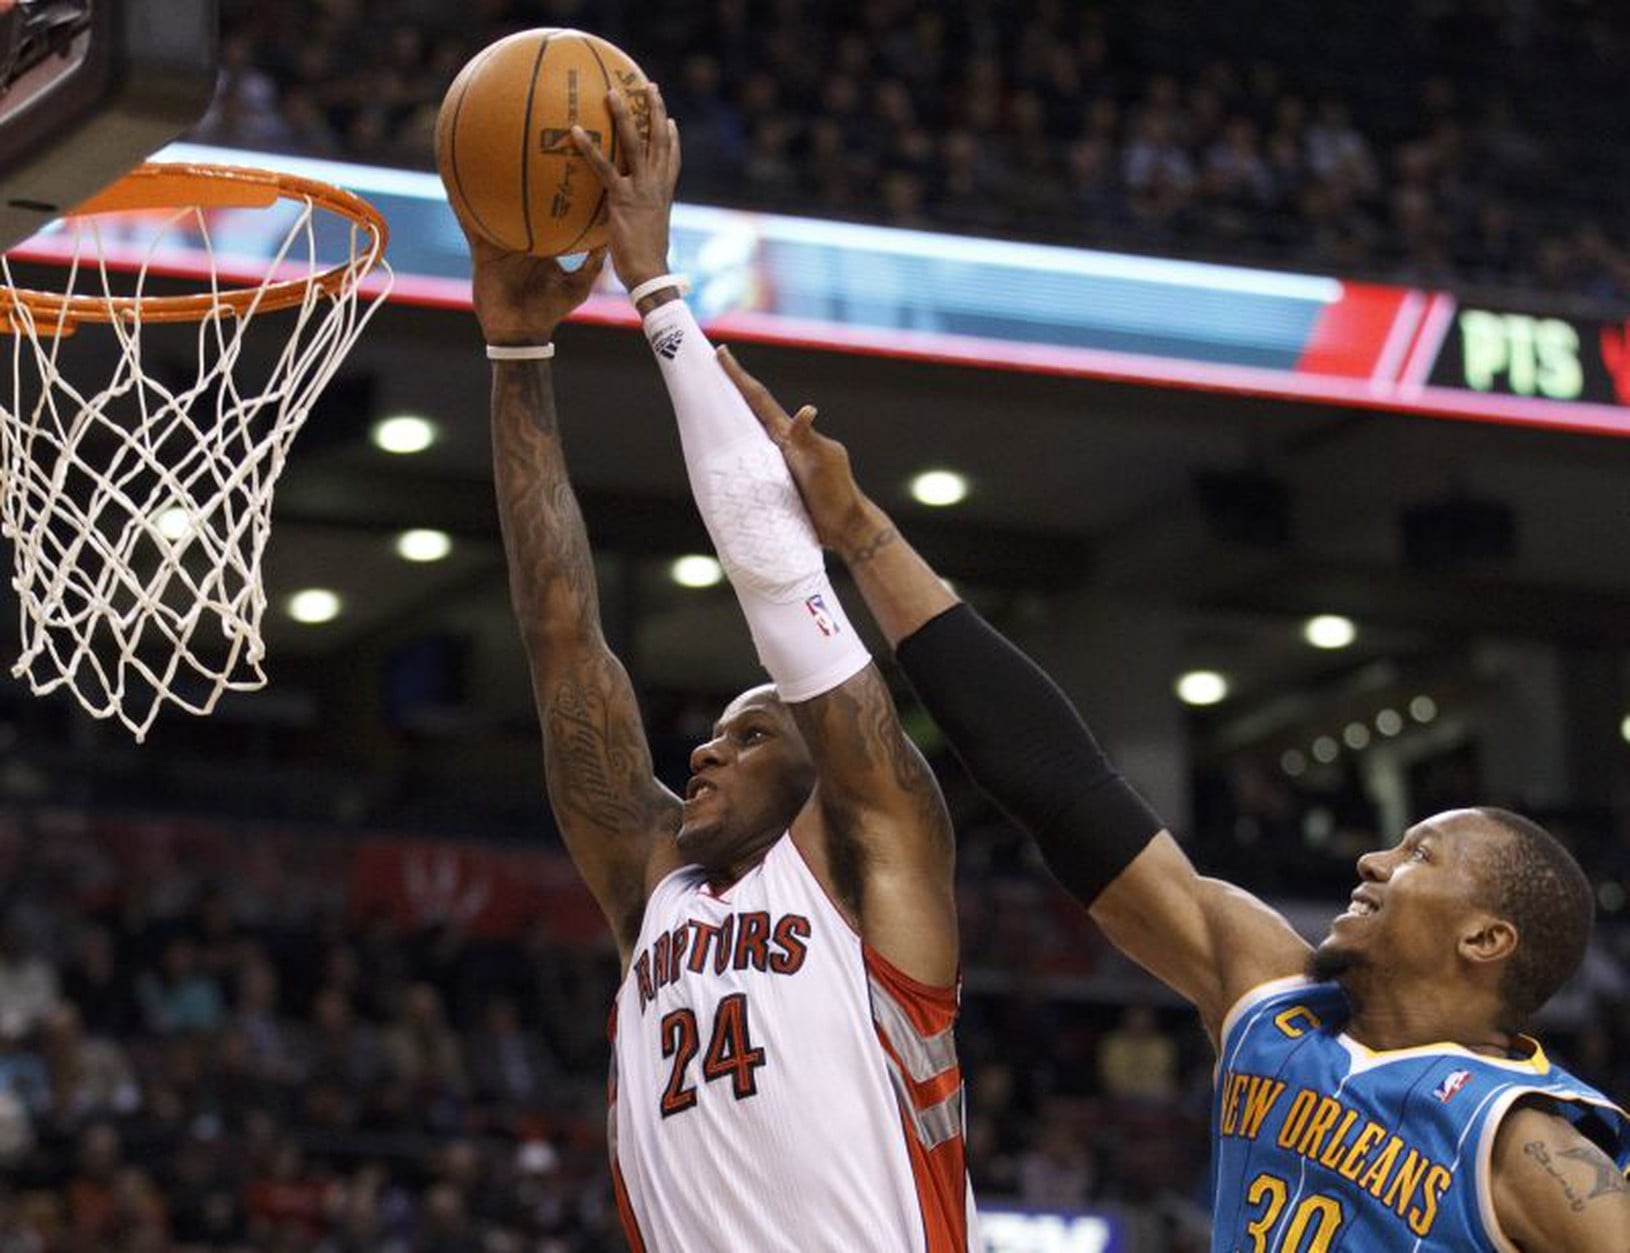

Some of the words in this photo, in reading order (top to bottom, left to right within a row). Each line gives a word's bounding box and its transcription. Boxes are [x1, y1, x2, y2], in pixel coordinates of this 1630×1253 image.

[1459, 309, 1584, 399] PTS
[633, 911, 812, 1015] RAPTORS
[660, 993, 766, 1119] 24
[1274, 1005, 1320, 1038] C
[1220, 1070, 1286, 1139] NEW
[1276, 1087, 1453, 1238] ORLEANS
[1246, 1173, 1344, 1253] 30
